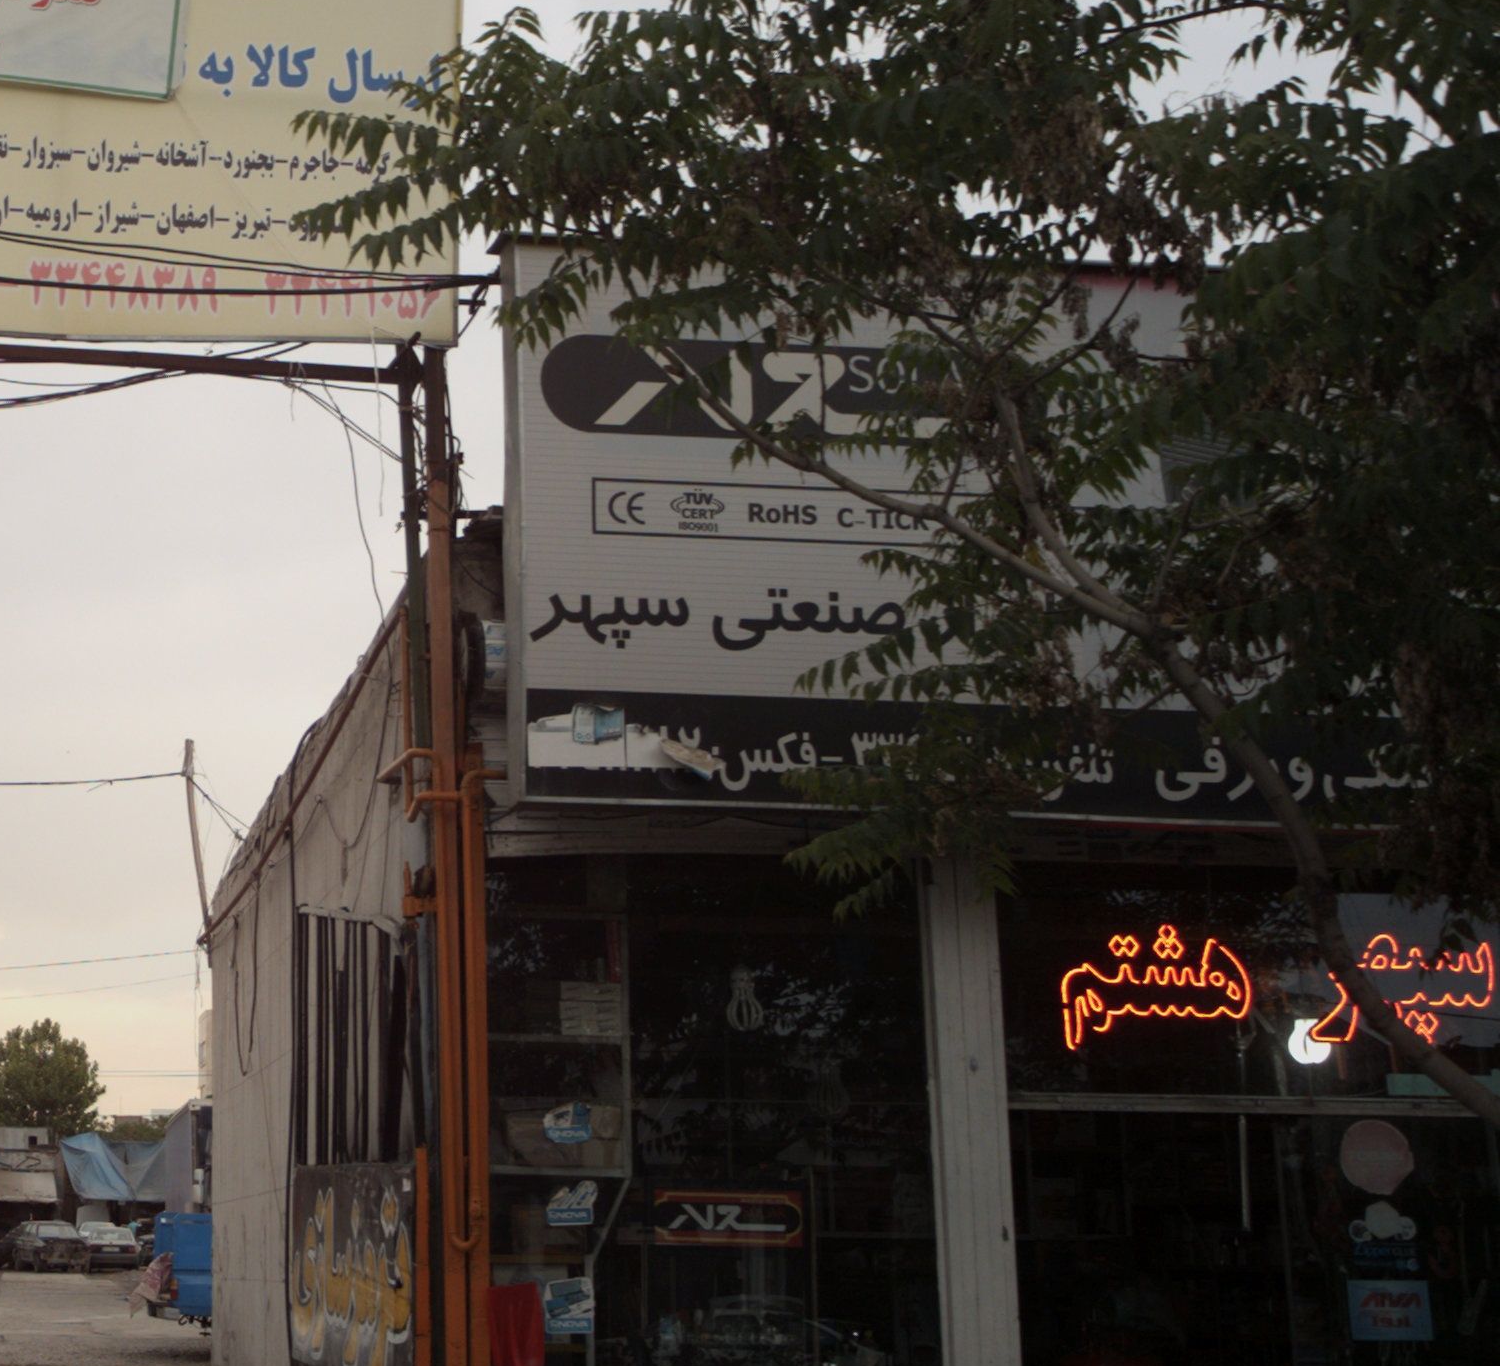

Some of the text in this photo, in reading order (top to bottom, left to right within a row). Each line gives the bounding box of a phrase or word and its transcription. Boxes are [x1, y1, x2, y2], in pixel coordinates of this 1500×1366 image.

[198, 51, 235, 96] به
[246, 43, 316, 88] کالا
[29, 259, 218, 314] ۳۳۴۴۸۳۸۹
[682, 507, 717, 520] CERT
[683, 488, 714, 506] TÜV
[748, 503, 818, 526] RoHS
[528, 592, 690, 649] سپهر
[712, 587, 904, 652] صنعتی
[1061, 925, 1250, 1050] هشتم
